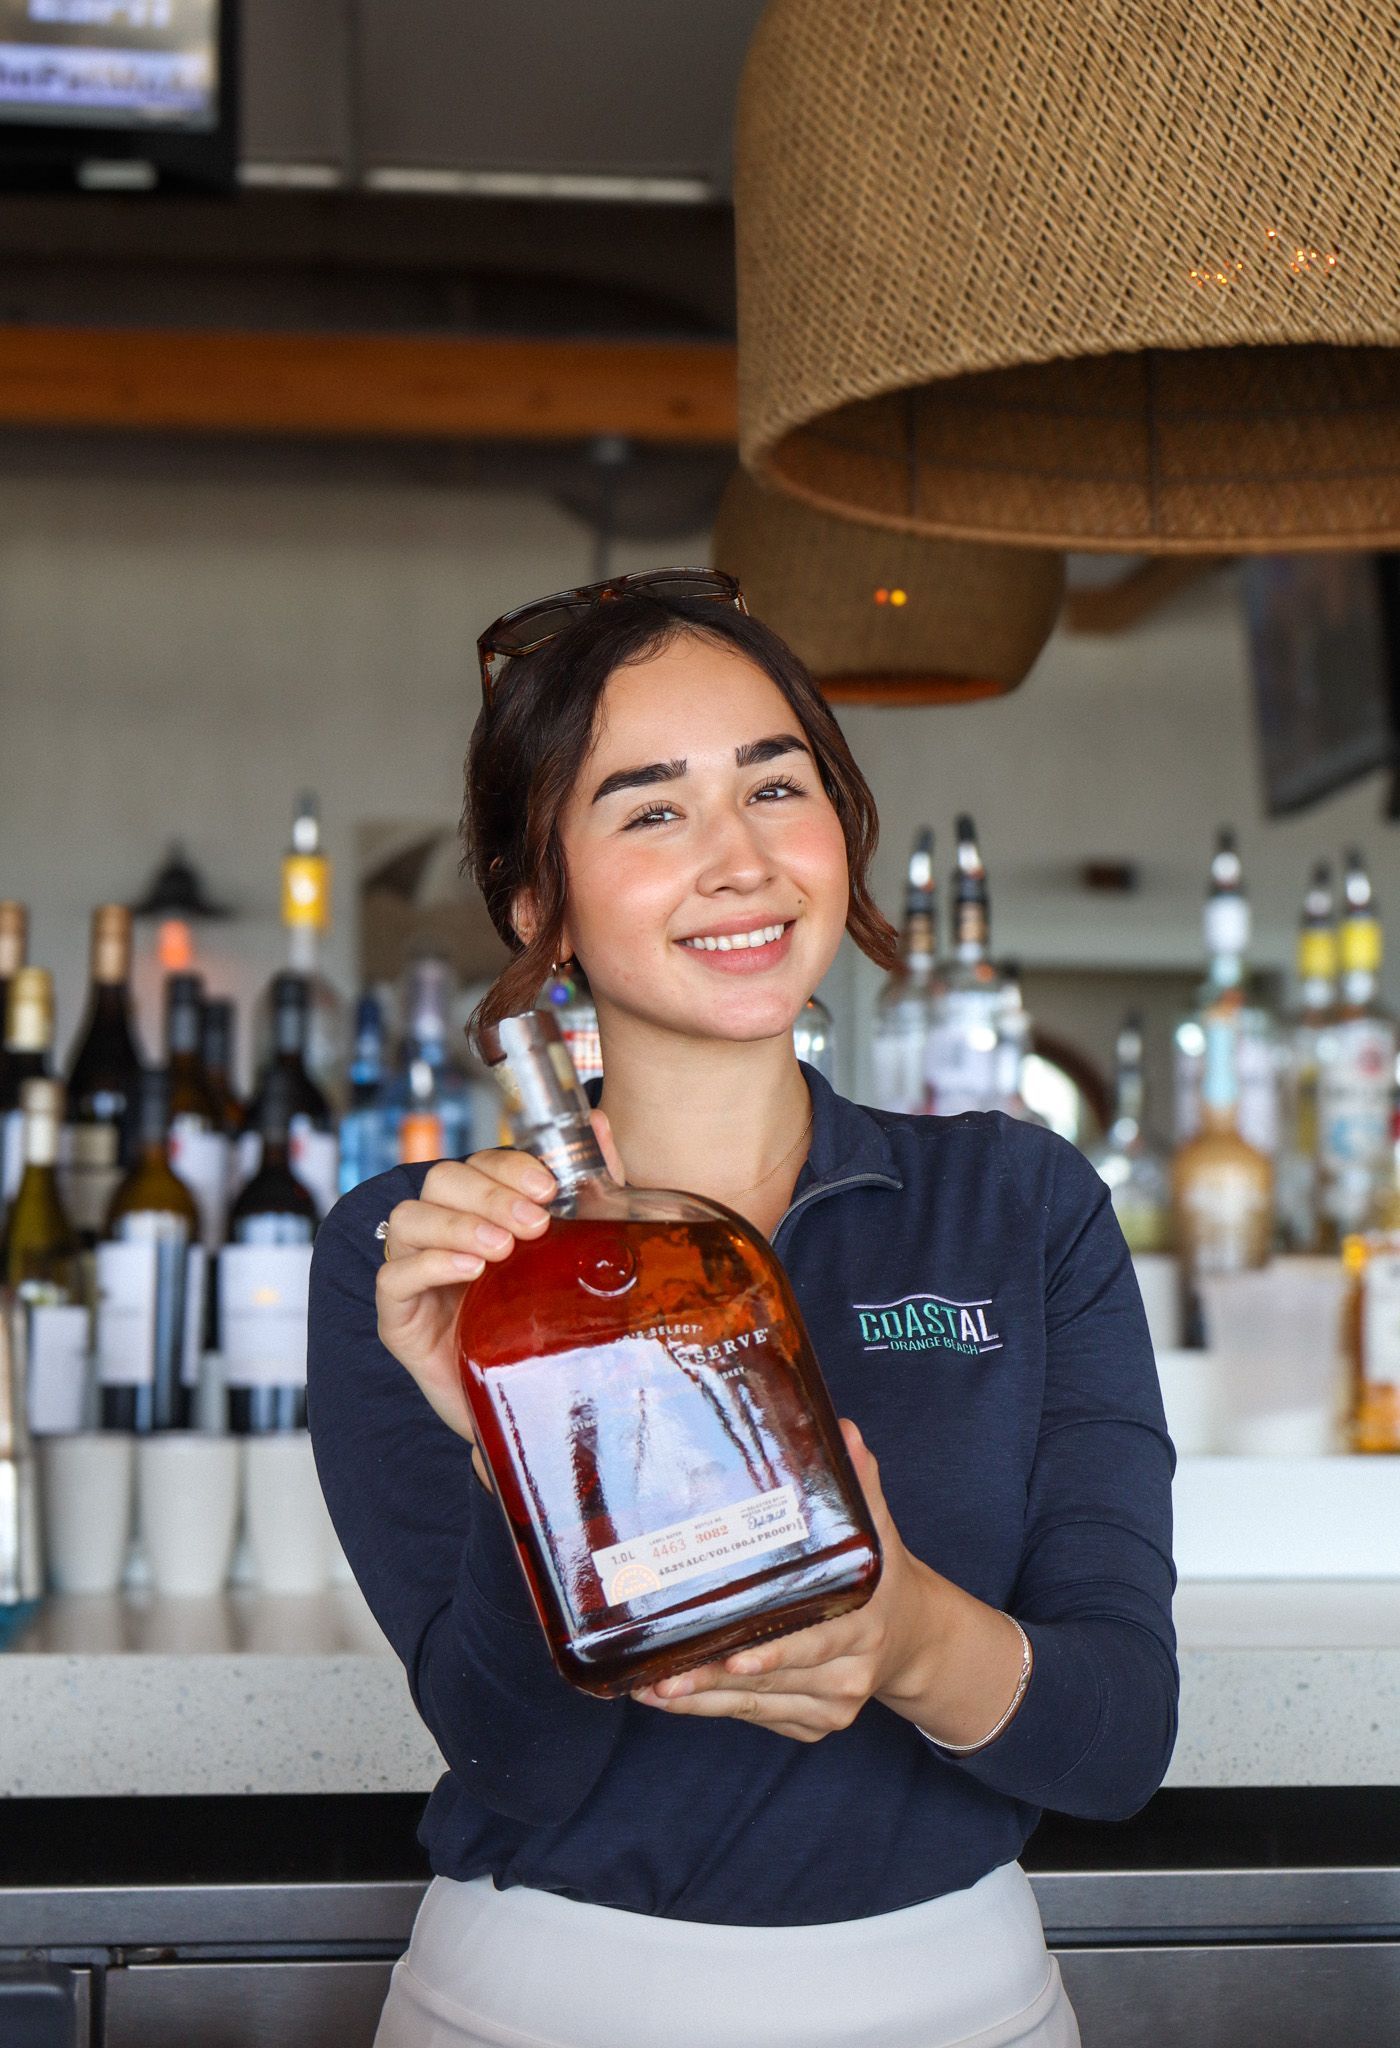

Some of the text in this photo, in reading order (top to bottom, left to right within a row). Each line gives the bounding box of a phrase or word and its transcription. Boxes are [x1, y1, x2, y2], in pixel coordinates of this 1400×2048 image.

[649, 1323, 700, 1337] SELECT
[859, 1302, 999, 1342] COASTAL
[890, 1337, 979, 1356] ORANGE BEACH
[652, 1539, 687, 1559] 4463
[695, 1524, 729, 1544] 3082
